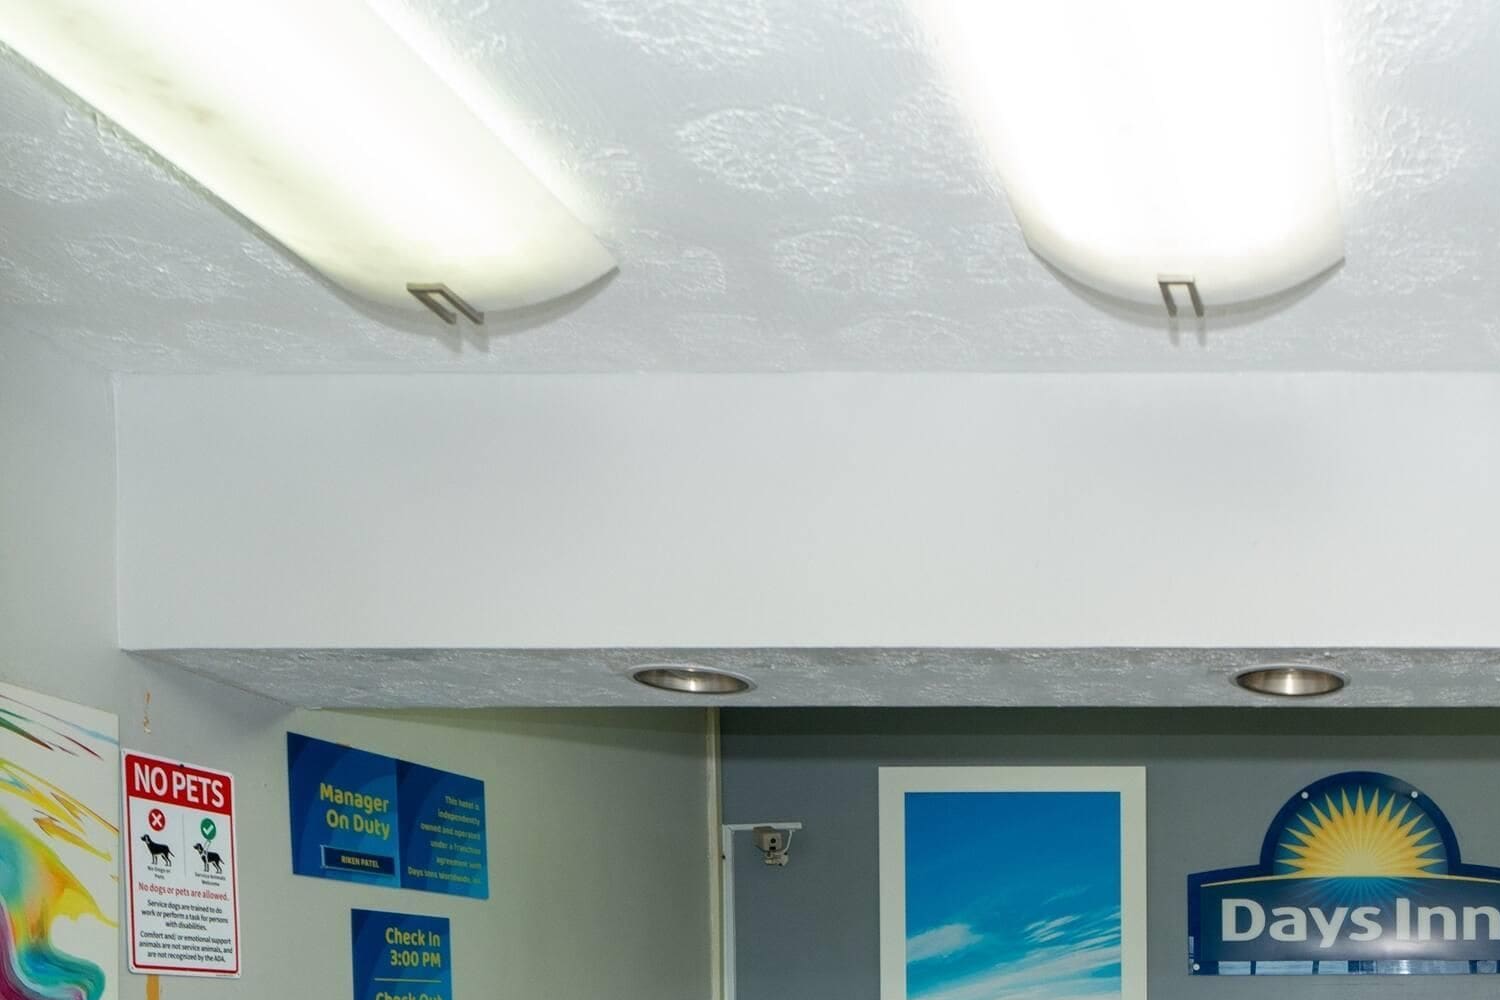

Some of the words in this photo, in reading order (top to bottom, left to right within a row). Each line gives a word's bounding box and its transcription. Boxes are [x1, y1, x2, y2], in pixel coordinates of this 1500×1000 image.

[134, 762, 168, 796] NO
[172, 770, 224, 808] PETS
[320, 782, 389, 814] Manager
[326, 809, 349, 829] On
[353, 814, 390, 840] Duty
[361, 858, 380, 868] PATEL
[408, 865, 424, 878] Days
[138, 881, 149, 891] No
[150, 883, 166, 895] dogs
[175, 888, 190, 897] pets
[202, 890, 230, 901] allowed.
[147, 899, 167, 908] Service
[168, 902, 180, 911] dogs
[190, 904, 209, 913] trained
[163, 911, 184, 919] perform
[178, 922, 207, 931] disabilities.
[1222, 898, 1383, 948] Days
[140, 930, 164, 939] Comfort
[184, 934, 210, 943] emotional
[211, 937, 231, 945] support
[385, 927, 425, 946] Check
[428, 931, 440, 947] In
[139, 941, 161, 949] animals
[201, 945, 223, 953] animals,
[168, 952, 197, 961] recognized
[198, 954, 204, 962] by
[390, 949, 419, 967] 3:00
[422, 952, 441, 968] PM
